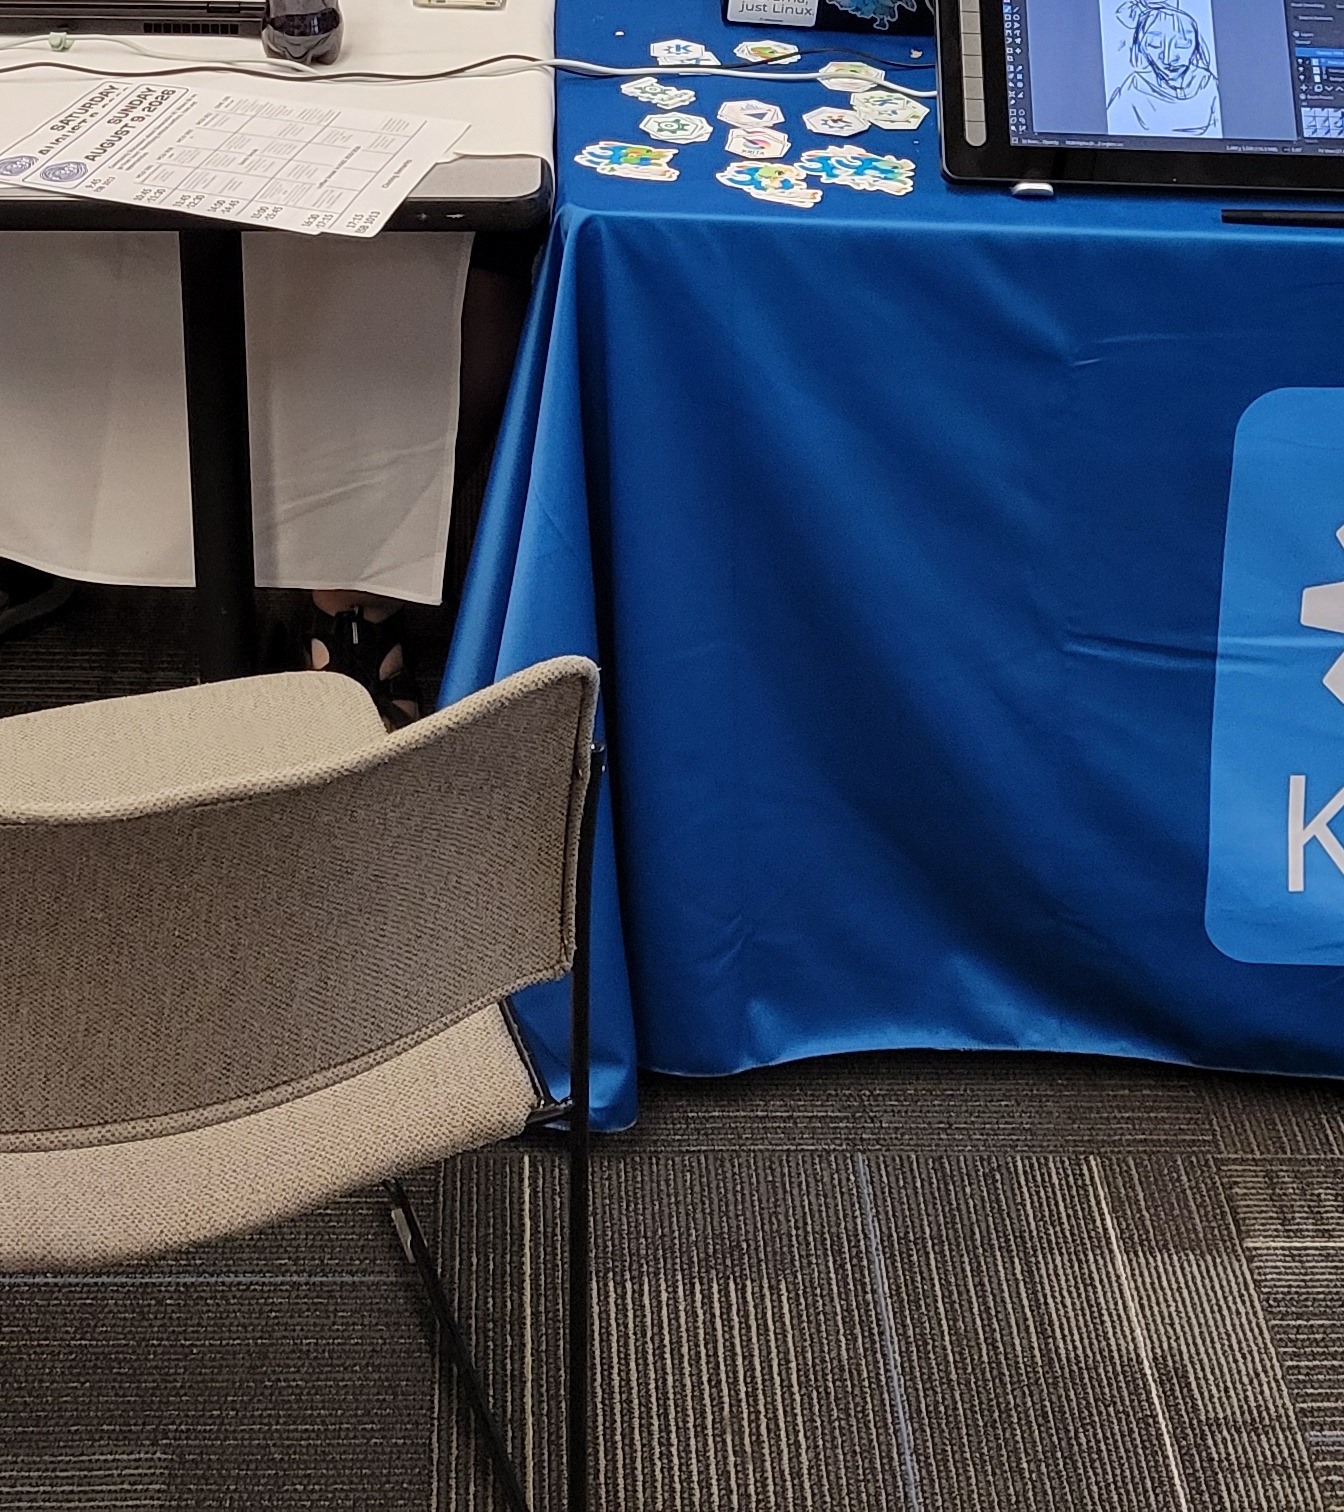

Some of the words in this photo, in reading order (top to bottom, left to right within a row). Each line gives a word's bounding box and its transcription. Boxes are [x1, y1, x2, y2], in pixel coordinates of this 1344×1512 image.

[738, 0, 768, 13] just
[772, 2, 815, 17] Linux.
[50, 84, 119, 132] SATURDAY
[84, 123, 136, 162] AUGUST
[141, 89, 176, 113] 2026
[107, 87, 157, 125] SUNDAY
